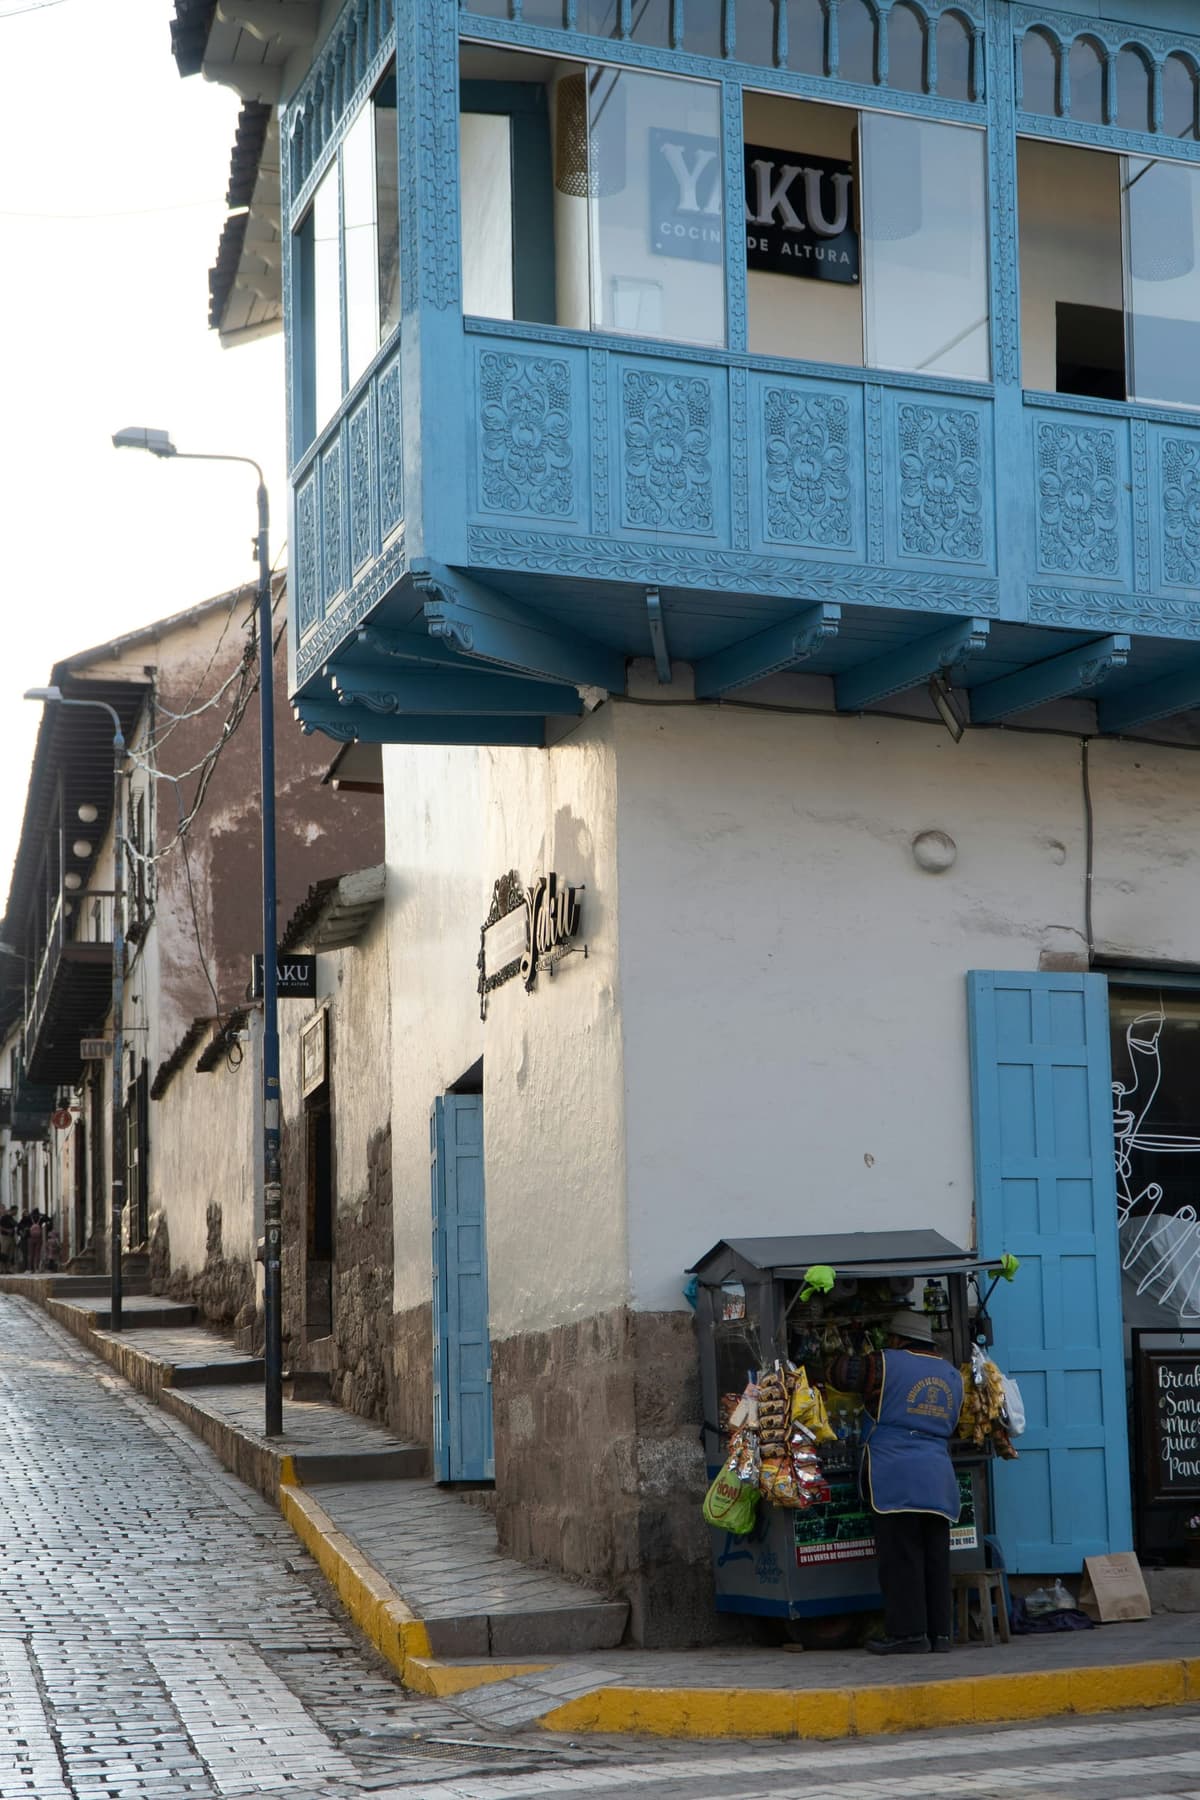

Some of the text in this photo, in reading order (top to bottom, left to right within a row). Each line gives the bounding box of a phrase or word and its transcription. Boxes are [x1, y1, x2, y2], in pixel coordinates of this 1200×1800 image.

[660, 222, 850, 265] COCIN DE ALTURA
[260, 965, 309, 980] AKU
